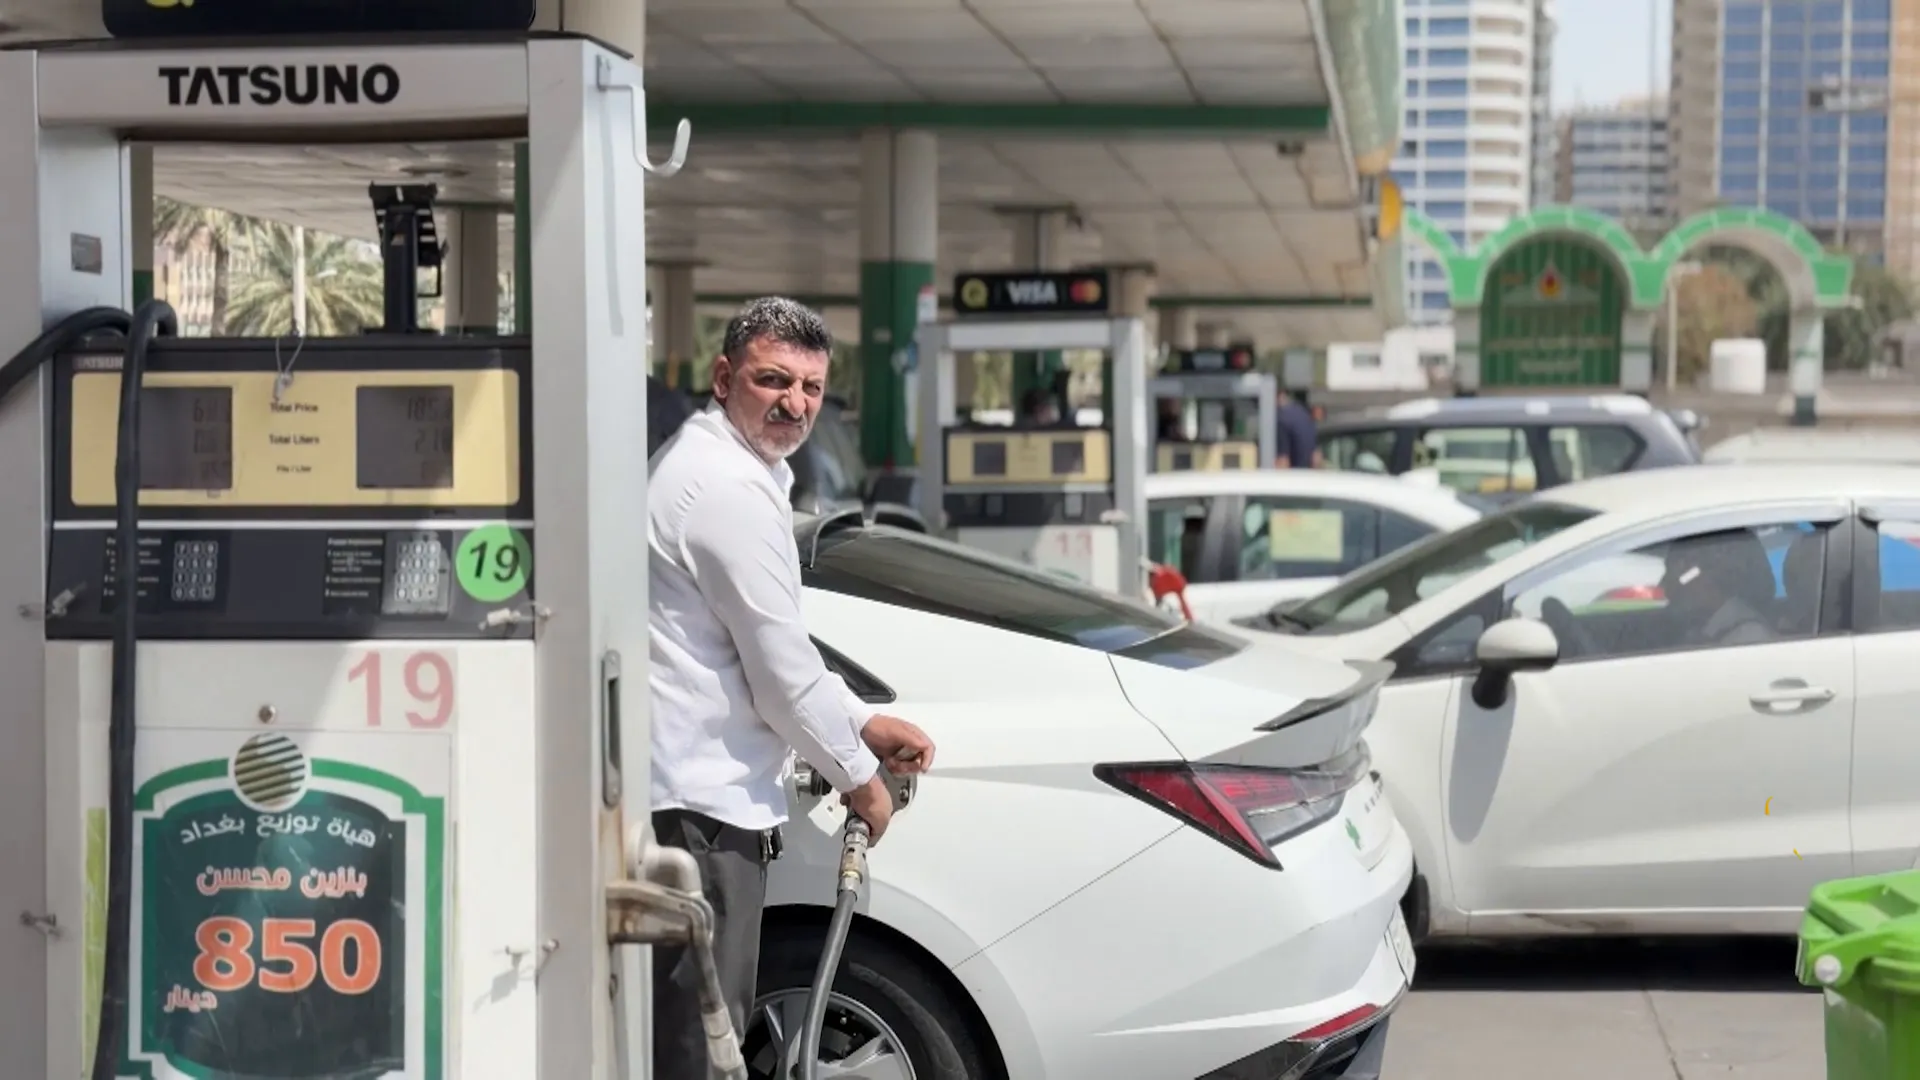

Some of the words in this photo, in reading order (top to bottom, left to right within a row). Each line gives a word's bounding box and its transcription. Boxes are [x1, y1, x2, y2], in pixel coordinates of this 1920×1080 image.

[158, 63, 400, 106] TATSUNO
[1007, 279, 1059, 305] VISA
[270, 402, 292, 412] Total
[294, 402, 319, 412] Price
[269, 434, 291, 444] Total
[468, 540, 520, 583] 19
[347, 649, 454, 729] 19
[181, 815, 246, 845] بغداد
[257, 813, 321, 839] توزيع
[196, 864, 292, 896] محسن
[300, 866, 368, 899] بنزين
[193, 916, 381, 994] 850
[164, 984, 218, 1012] دينار
